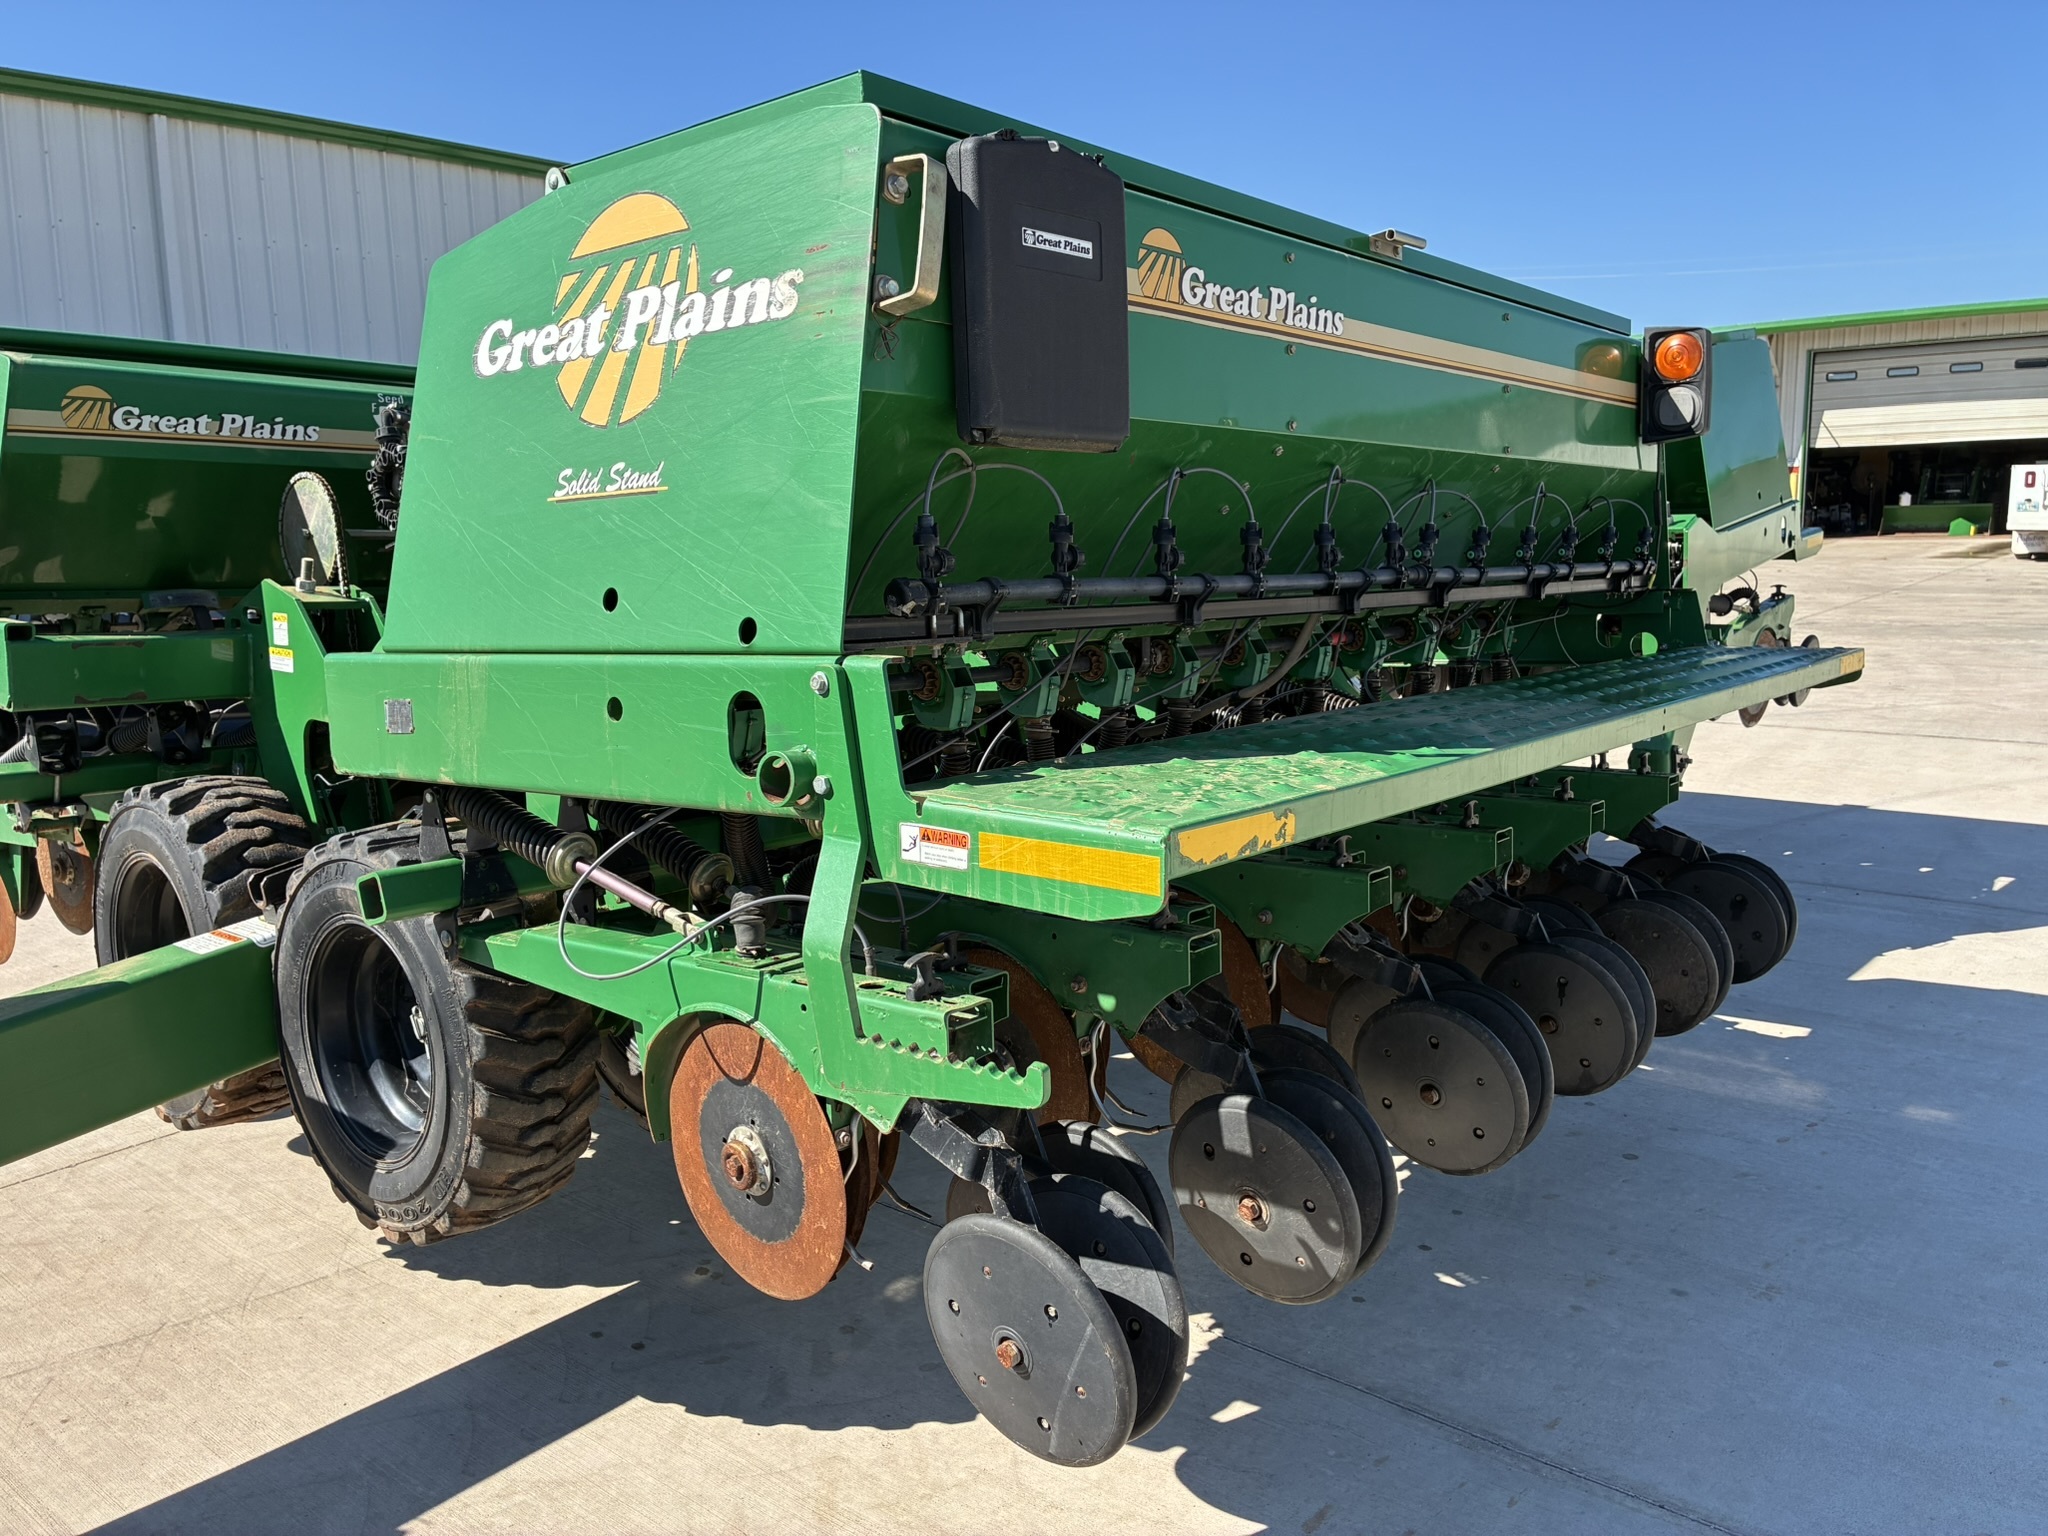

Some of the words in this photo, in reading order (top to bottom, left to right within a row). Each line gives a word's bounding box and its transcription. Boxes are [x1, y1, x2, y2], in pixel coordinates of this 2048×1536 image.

[1036, 234, 1062, 249] Great
[1063, 240, 1091, 255] Plains
[1181, 266, 1262, 319] Great
[1267, 286, 1344, 336] Plains
[473, 301, 612, 378] Great
[612, 267, 804, 352] Plains
[112, 405, 212, 435] Great
[217, 413, 320, 442] Plains
[554, 467, 603, 498] Solid
[605, 461, 665, 492] Stand
[931, 831, 966, 848] WARNING
